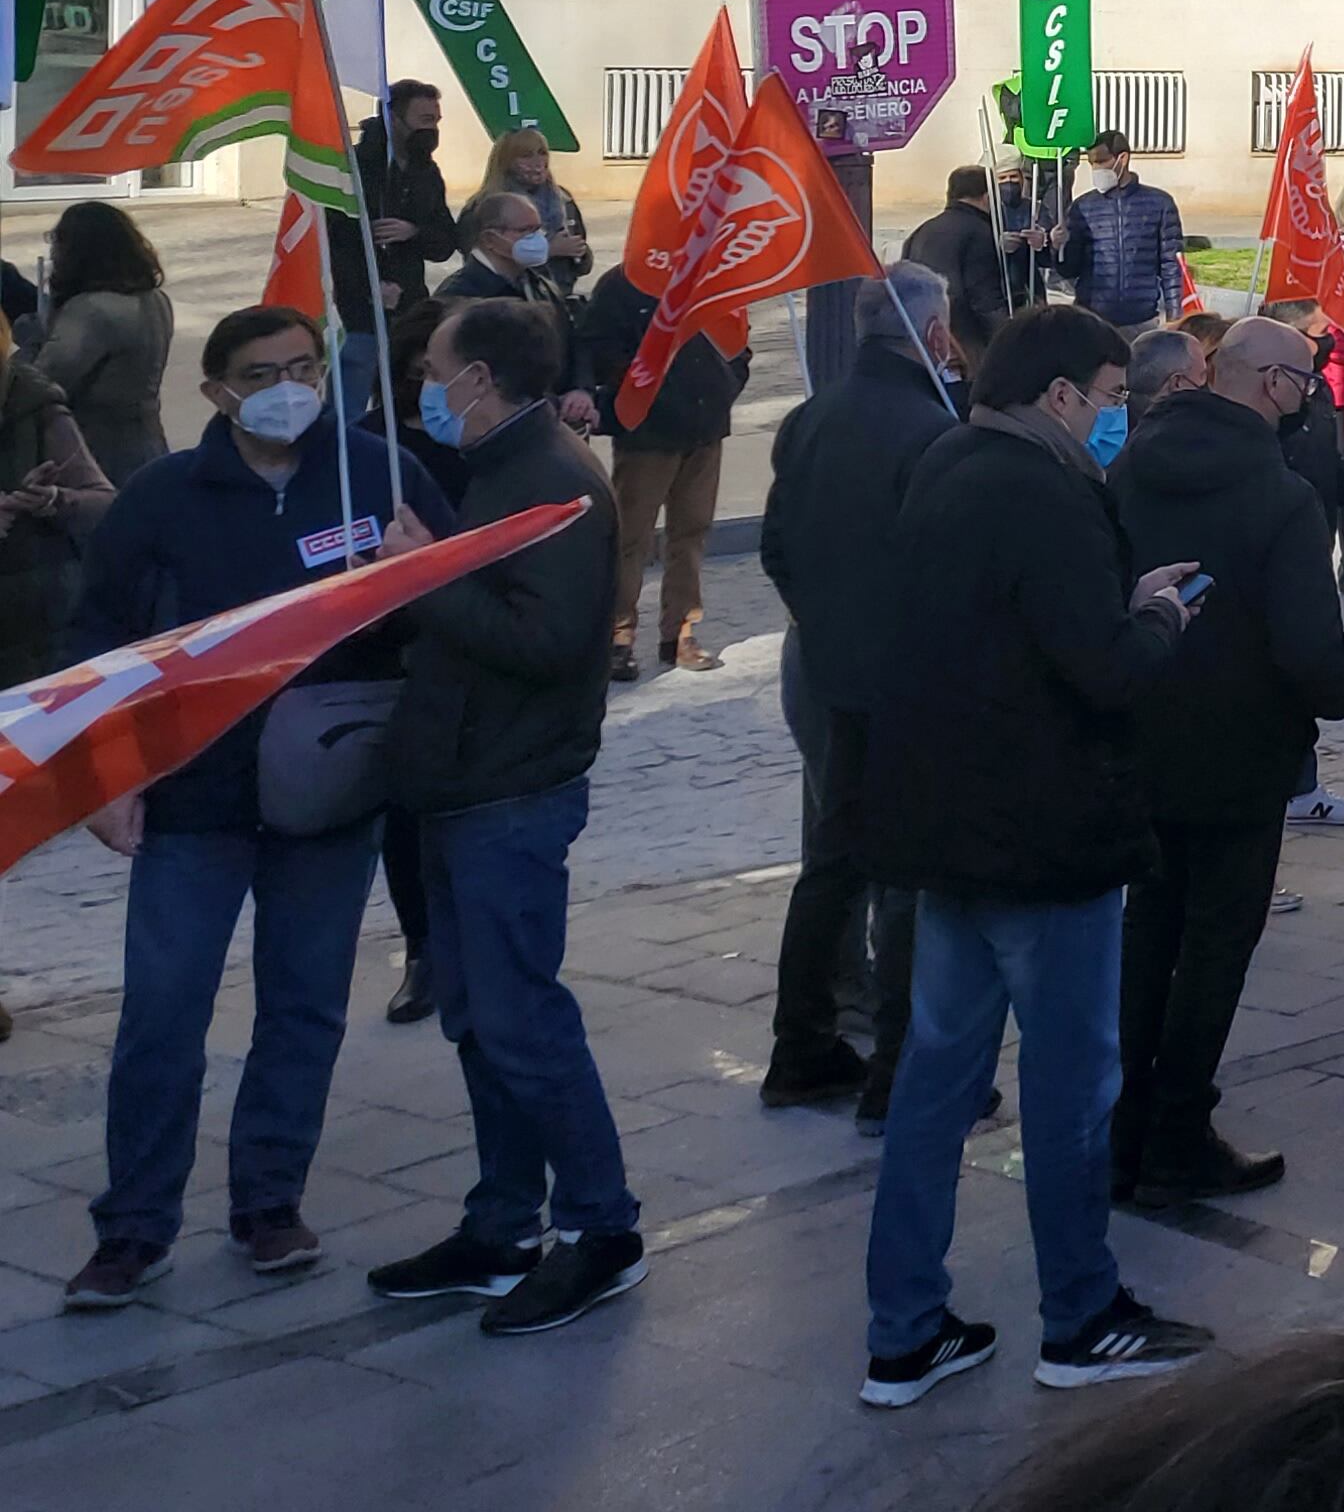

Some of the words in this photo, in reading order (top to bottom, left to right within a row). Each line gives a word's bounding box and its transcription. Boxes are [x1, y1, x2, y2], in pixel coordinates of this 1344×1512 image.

[790, 10, 927, 72] STOP
[1044, 4, 1068, 139] CSIF
[796, 88, 810, 104] A
